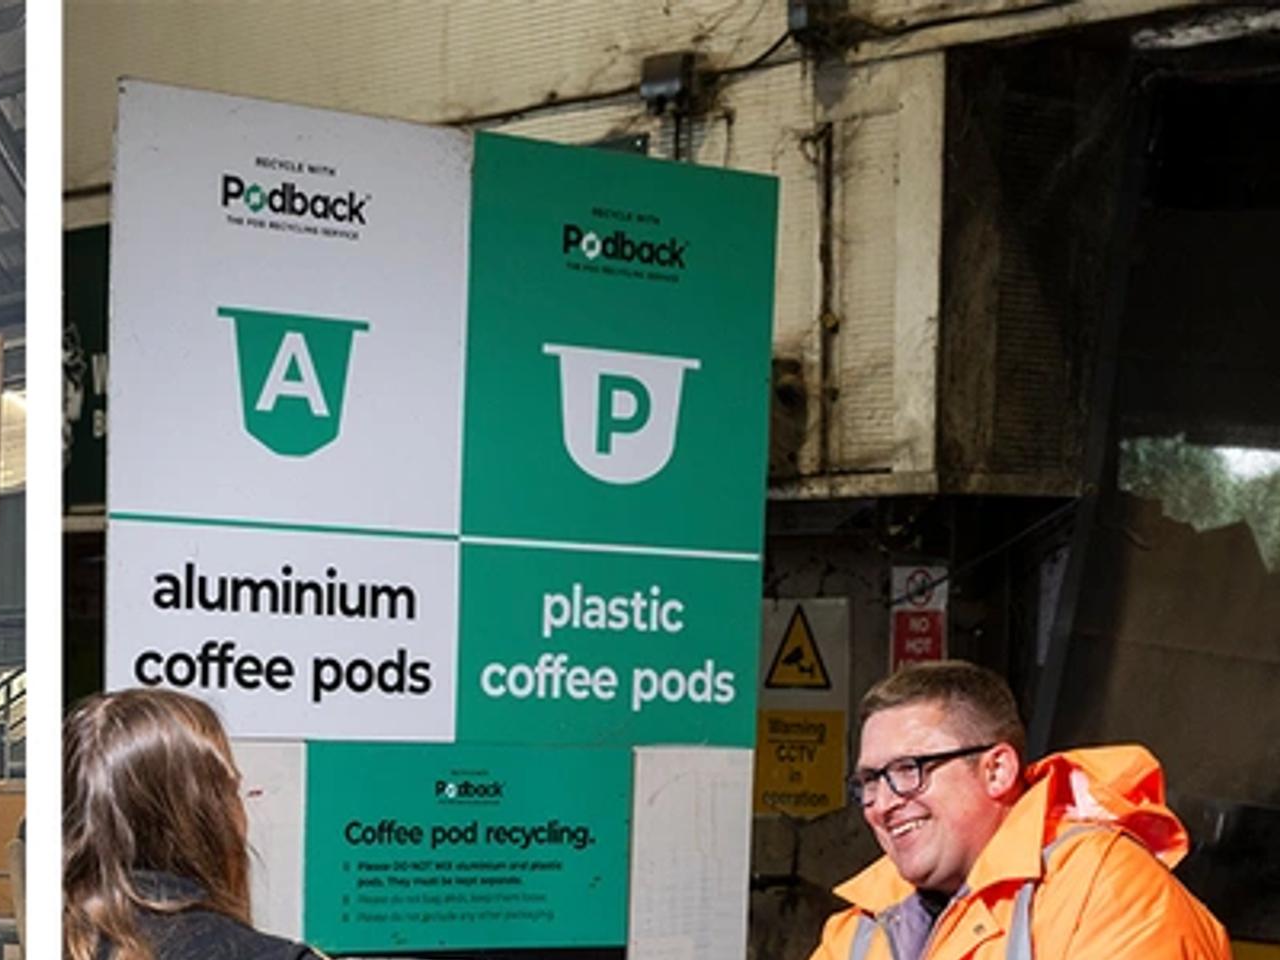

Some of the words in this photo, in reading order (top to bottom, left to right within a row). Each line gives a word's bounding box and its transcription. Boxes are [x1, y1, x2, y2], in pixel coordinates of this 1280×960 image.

[256, 157, 304, 173] RECYCLE
[307, 163, 336, 176] WITH
[222, 174, 366, 225] Podback
[563, 223, 686, 270] Podback
[255, 331, 331, 417] A
[595, 372, 652, 455] P
[152, 561, 417, 620] aluminium
[542, 582, 685, 638] plastic
[134, 640, 295, 690] coffee
[311, 648, 432, 703] pods
[480, 652, 619, 700] coffee
[631, 658, 736, 713] pods
[776, 743, 818, 764] CCTV
[344, 819, 424, 846] Coffee
[431, 820, 479, 850] pod
[485, 818, 596, 850] recycling.
